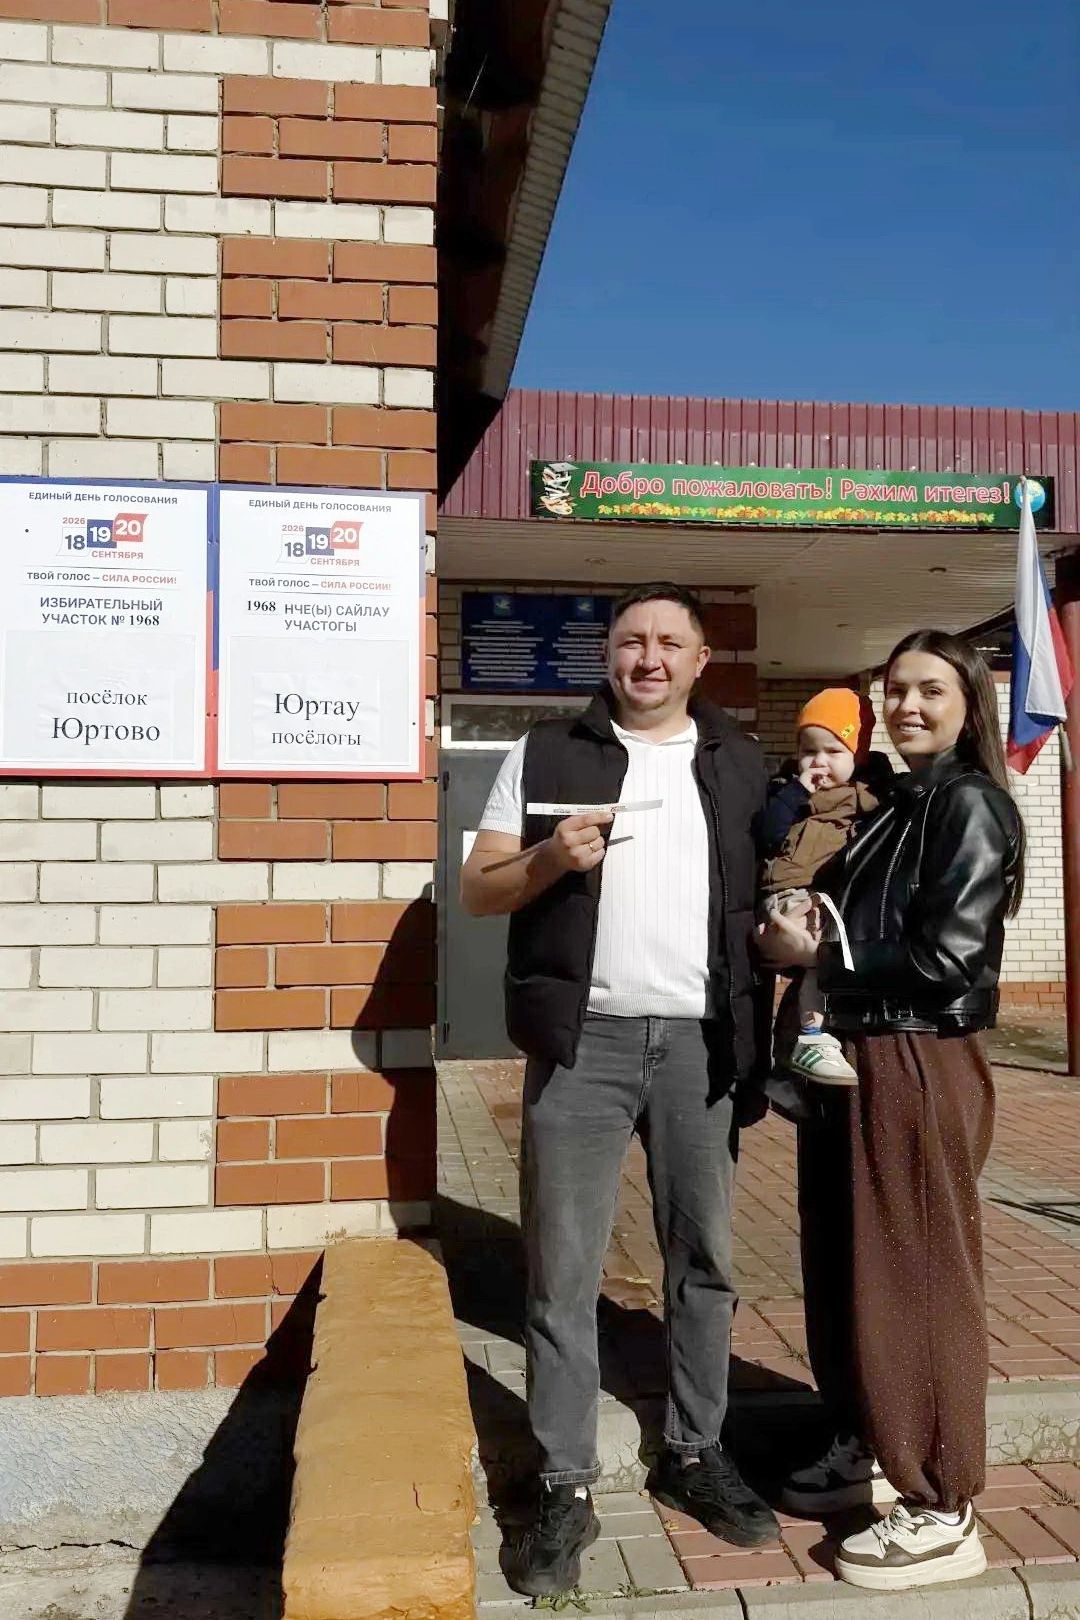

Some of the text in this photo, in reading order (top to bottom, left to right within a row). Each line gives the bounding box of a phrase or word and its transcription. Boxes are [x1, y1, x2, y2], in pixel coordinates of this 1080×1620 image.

[580, 471, 1011, 504] Добро пожаловать! Рәхим итегез!
[29, 491, 178, 505] ЕДИНЫЙ ДЕНЬ ГОЛОСОВАНИЯ
[249, 499, 392, 513] ЕДИНЫЙ ДЕНЬ ГОЛОСОВАНИЯ
[62, 517, 86, 525] 2026
[281, 524, 305, 532] 2026
[64, 520, 141, 551] 18 19 20
[284, 527, 357, 558] 18 19 20
[91, 550, 144, 560] СЕНТЯБРЯ
[310, 557, 360, 567] СЕНТЯБРЯ
[27, 572, 54, 580] ТВОЙ
[57, 573, 90, 581] ГОЛОС
[102, 574, 130, 583] СИЛА
[132, 575, 177, 584] РОССИИ!
[249, 578, 275, 587] ТВОЙ
[278, 580, 310, 588] ГОЛОС
[320, 581, 347, 589] СИЛА
[349, 582, 391, 591] РОССИИ!
[40, 597, 163, 611] ИЗБИРАТЕЛЬНЫЙ
[247, 600, 390, 618] 1968 НЧЕ(Ы) САЙЛАУ
[42, 613, 160, 626] УЧАСТОК № 1968
[284, 619, 357, 632] УЧАСТОГЫ
[67, 689, 148, 706] посёлок
[274, 693, 360, 721] Юртау
[51, 717, 161, 745] Юртово
[271, 730, 361, 746] посёлогы
